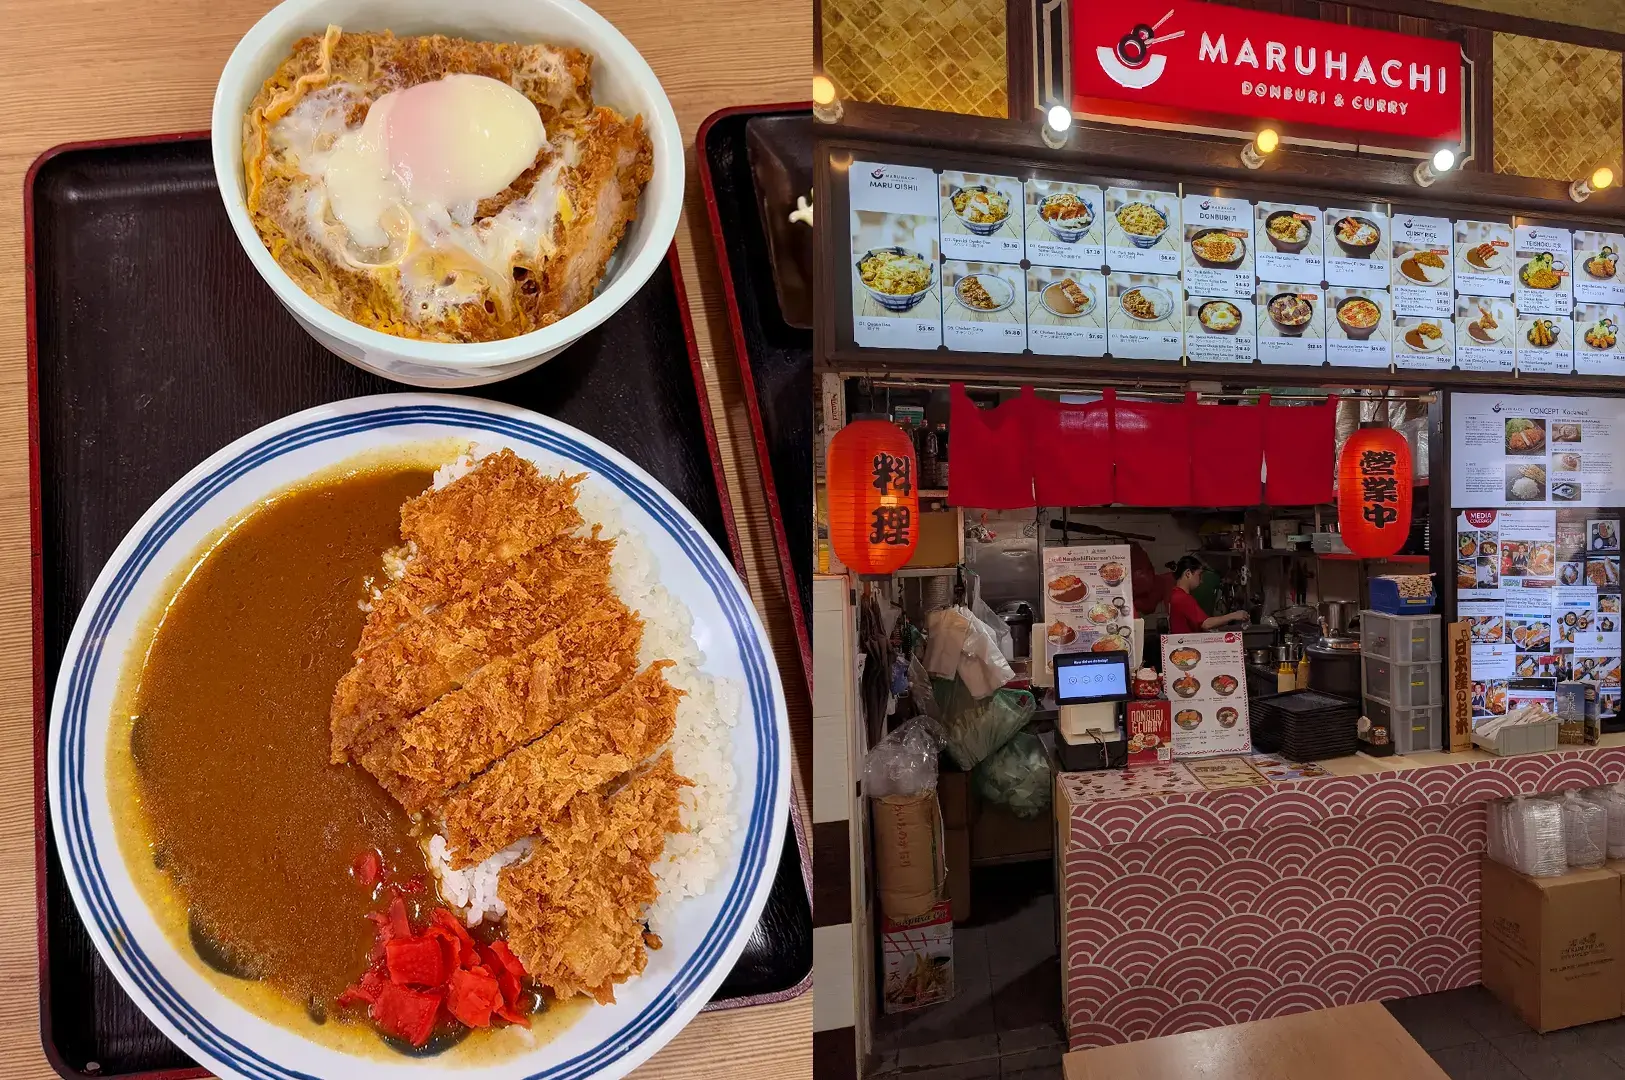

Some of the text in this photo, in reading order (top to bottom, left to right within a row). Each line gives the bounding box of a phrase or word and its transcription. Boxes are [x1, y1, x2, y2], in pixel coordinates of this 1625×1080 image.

[1199, 31, 1446, 94] MARUHACHI
[1241, 80, 1409, 115] DONBURI & CURRY
[870, 181, 893, 189] MARU
[1199, 212, 1231, 222] DONBURI
[1529, 407, 1559, 415] CONCEPT
[869, 452, 912, 546] 料理
[1131, 709, 1164, 722] DONBURI
